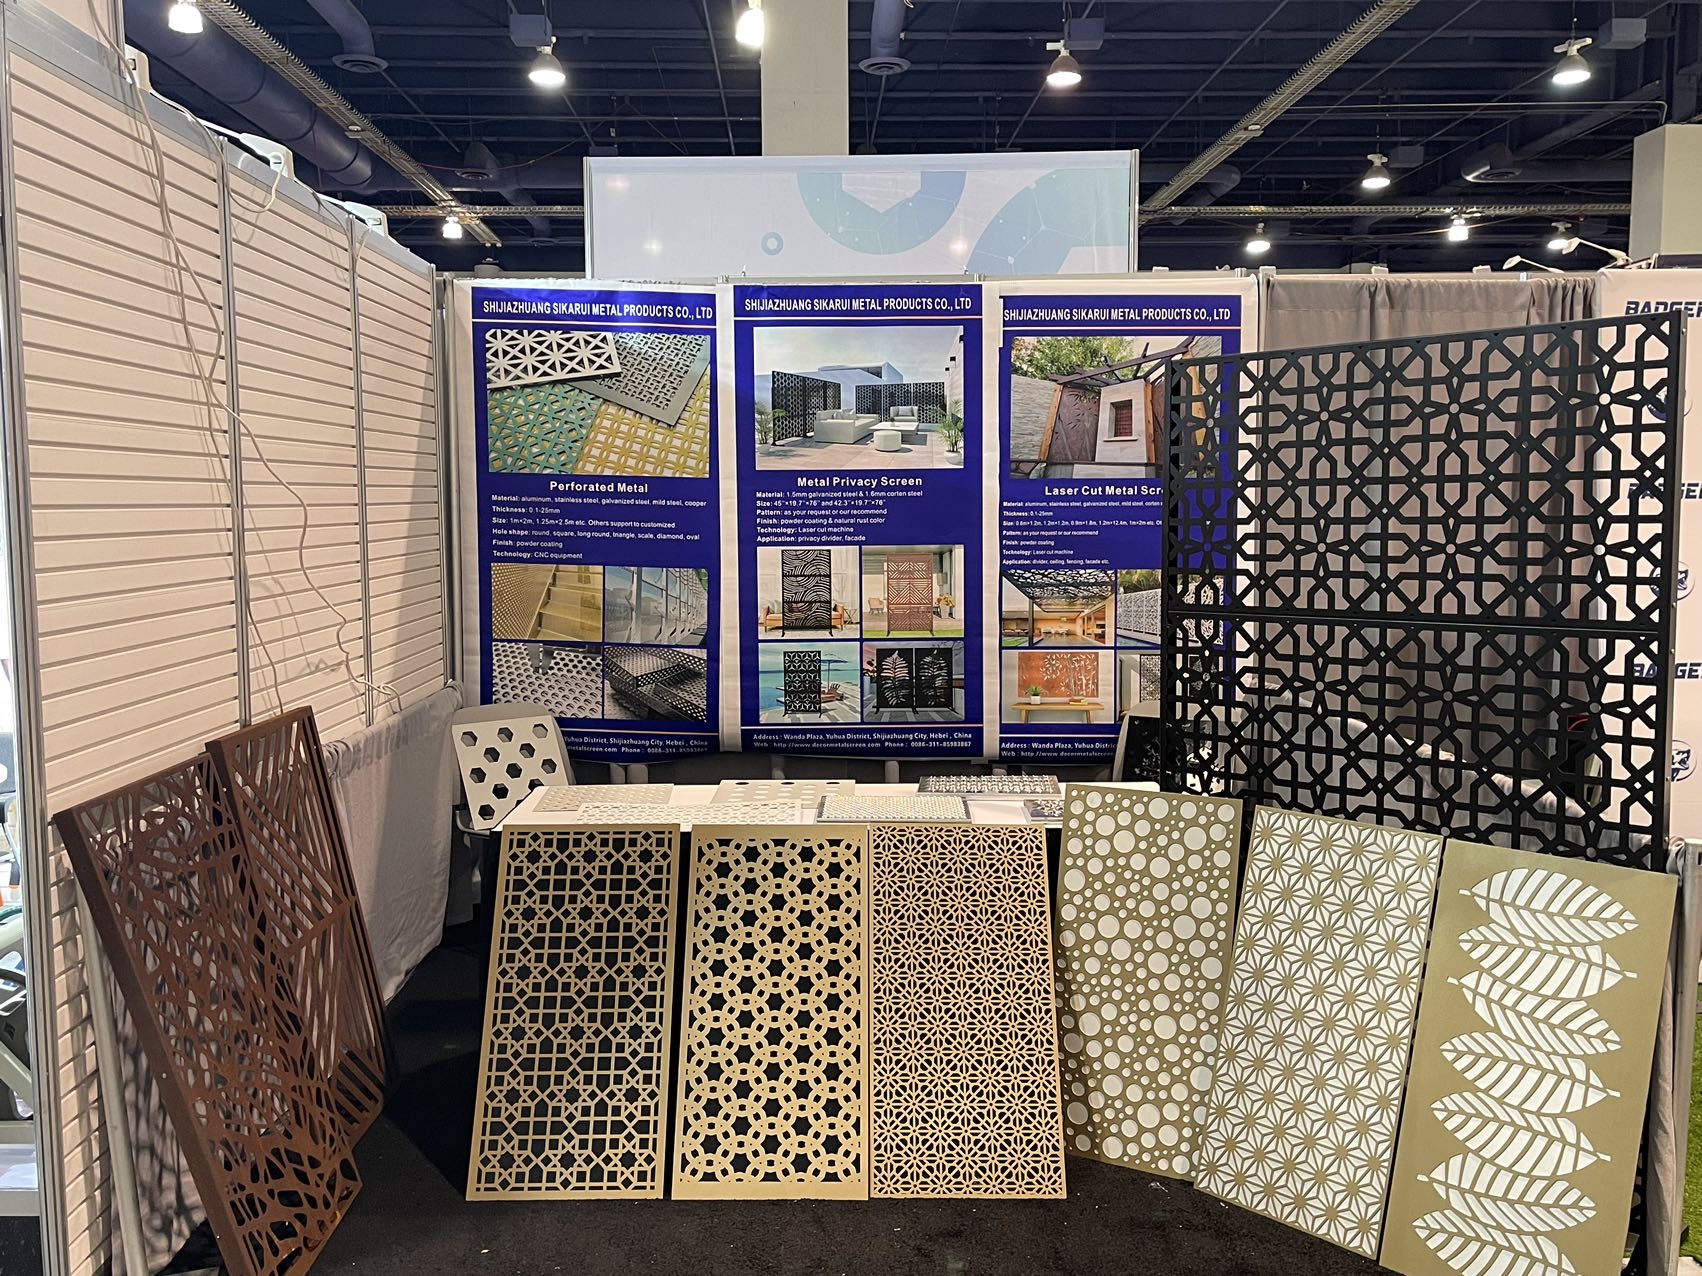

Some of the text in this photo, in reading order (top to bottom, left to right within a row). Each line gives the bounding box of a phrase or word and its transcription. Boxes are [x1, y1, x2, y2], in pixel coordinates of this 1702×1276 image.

[745, 297, 971, 311] SHIJIAZHUANG SIKARUI METAL PRODUCTS CO., LTD
[483, 300, 713, 320] SHIJIAZHUANG SIKARUI METAL PRODUCTS CO., LTD
[1004, 308, 1230, 322] SHIJIAZHUANG SIKARUI METAL PRODUCTS CO., LTD
[797, 476, 923, 488] Metal Privacy Screen
[550, 481, 648, 493] Perforated Metal
[1045, 485, 1163, 495] Laser Cut Metal Scr
[808, 491, 842, 499] galvanized
[601, 498, 634, 506] galvanized
[640, 521, 676, 529] customized
[577, 530, 591, 538] long
[757, 526, 797, 534] Technology:
[757, 535, 797, 543] Application:
[493, 550, 533, 559] Technology:
[872, 732, 913, 741] Shijiazhuang
[914, 732, 928, 740] City,
